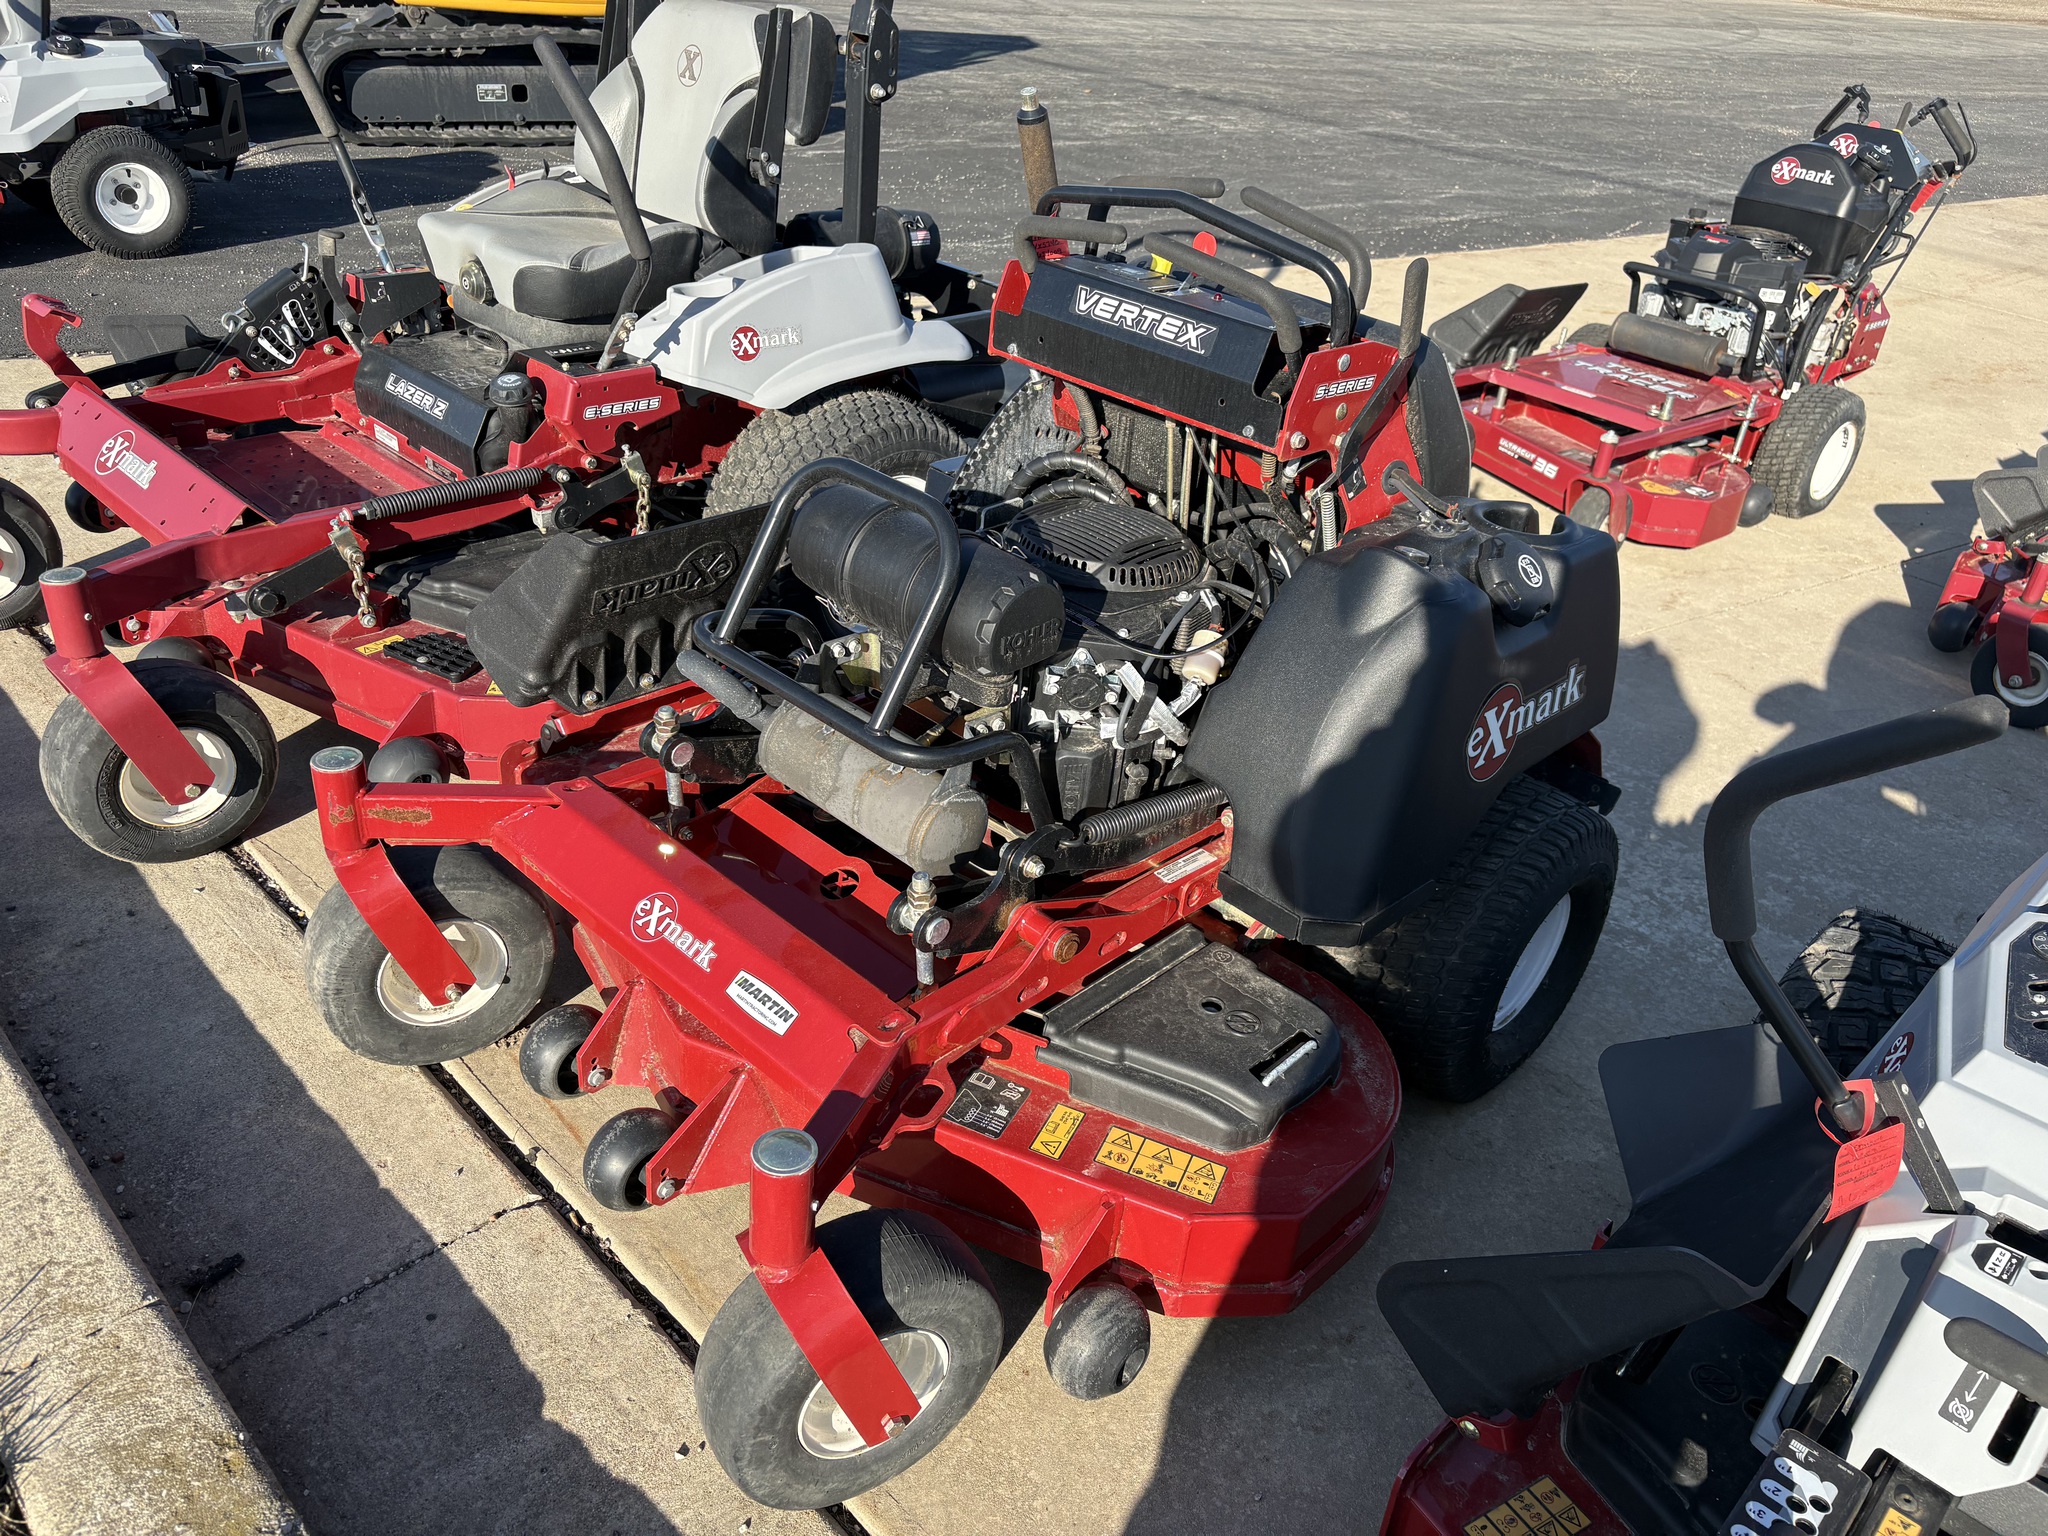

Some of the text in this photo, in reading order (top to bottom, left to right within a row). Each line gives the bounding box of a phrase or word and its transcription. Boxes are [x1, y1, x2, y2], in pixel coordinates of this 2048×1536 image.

[1076, 285, 1216, 354] VERTEX
[1574, 360, 1698, 400] TRACER
[1606, 362, 1690, 388] TURF
[386, 373, 449, 420] LAZER Z
[1532, 456, 1559, 480] 36
[1000, 618, 1062, 656] KOHLER
[735, 976, 795, 1024] MARTIN
